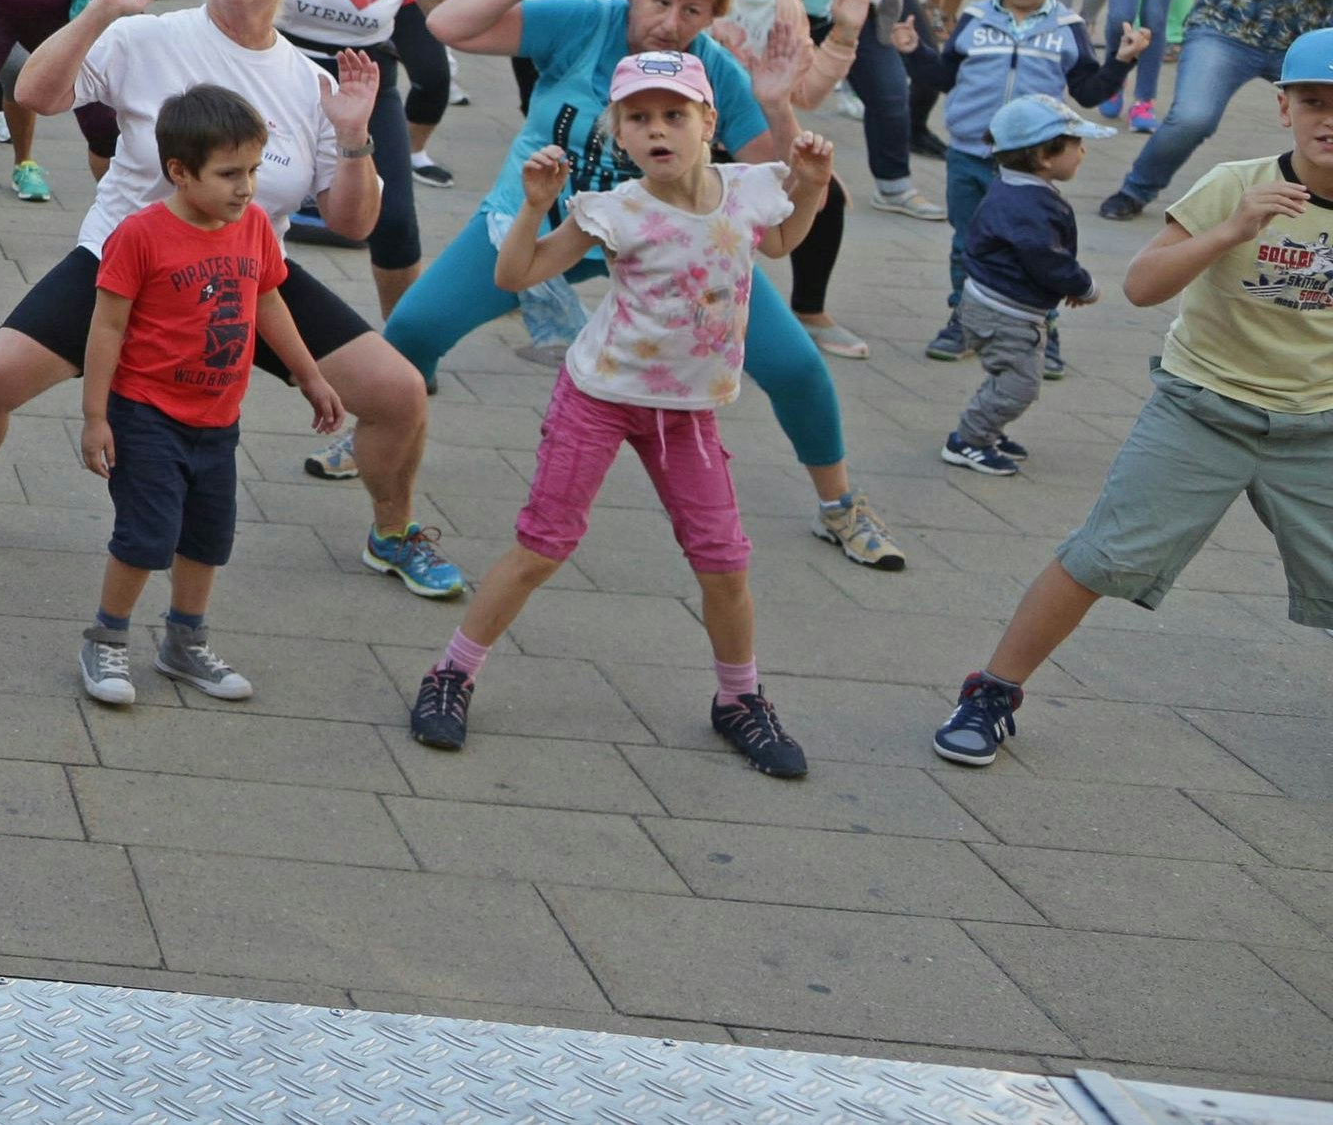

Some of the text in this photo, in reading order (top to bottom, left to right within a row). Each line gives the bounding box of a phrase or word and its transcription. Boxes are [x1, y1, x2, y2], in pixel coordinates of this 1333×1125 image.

[296, 0, 380, 29] VIENNA
[170, 255, 233, 293] PIRATES
[174, 367, 206, 386] WILD
